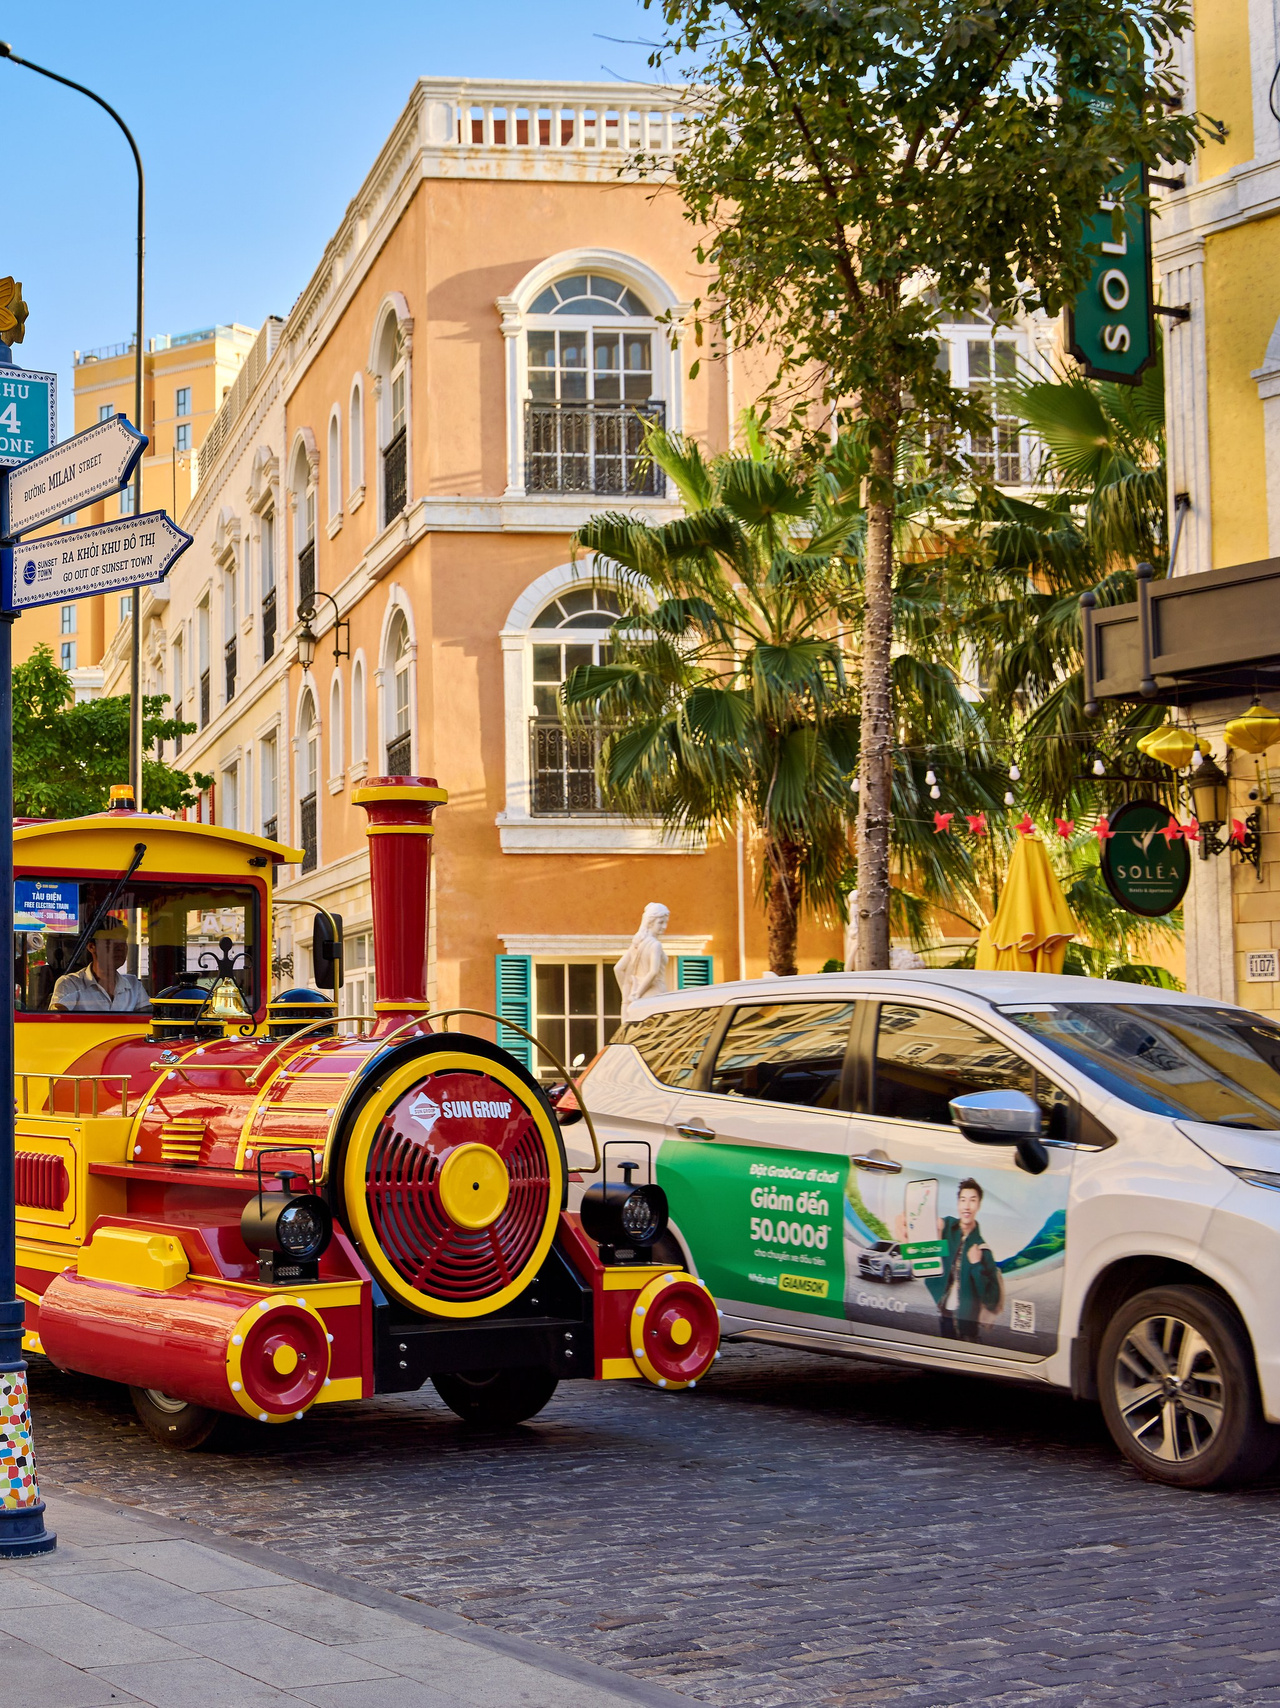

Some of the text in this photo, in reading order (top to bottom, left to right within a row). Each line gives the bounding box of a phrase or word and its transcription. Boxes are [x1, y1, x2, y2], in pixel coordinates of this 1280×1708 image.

[1098, 163, 1131, 353] SOL
[24, 453, 102, 502] ĐƯỜNG MILAN STREET
[62, 532, 156, 564] RA KHỎI KHU ĐÔ THỊ
[37, 558, 58, 569] SUNSET
[63, 571, 73, 583] GO
[74, 568, 89, 580] OUT
[90, 566, 100, 577] OF
[102, 559, 129, 575] SUNSET
[131, 555, 153, 569] TOWN
[37, 568, 53, 578] TOWN
[1116, 862, 1180, 879] SOLÉA
[31, 890, 62, 902] TÀU ĐIỆN
[1255, 959, 1271, 972] 107
[442, 1100, 512, 1119] SUN GROUP
[767, 1165, 807, 1180] GrabCar
[806, 1168, 818, 1181] đi
[816, 1170, 840, 1183] chơi
[750, 1186, 829, 1216] Giảm đến
[754, 1248, 766, 1257] cho
[766, 1276, 778, 1285] mã
[782, 1277, 825, 1294] GIAM50K
[856, 1292, 909, 1313] GrabCar
